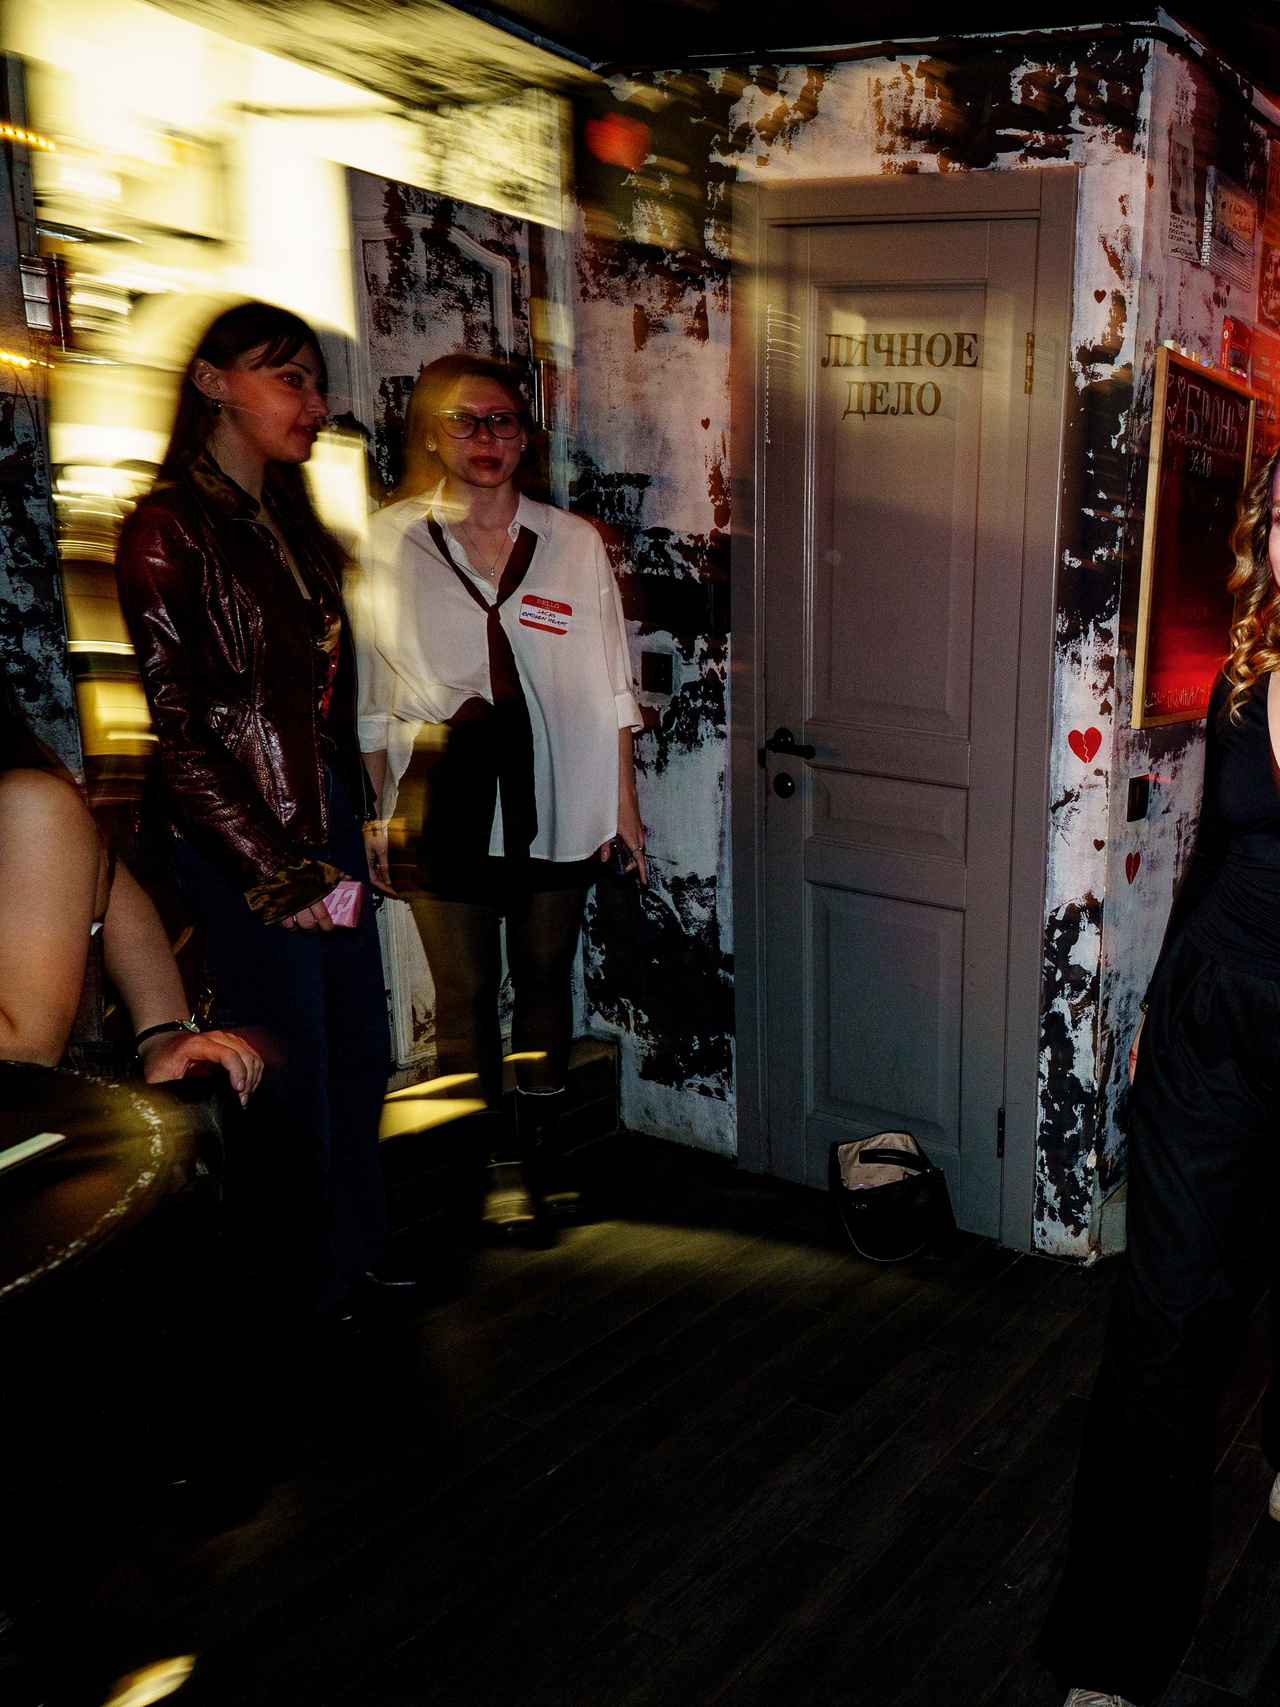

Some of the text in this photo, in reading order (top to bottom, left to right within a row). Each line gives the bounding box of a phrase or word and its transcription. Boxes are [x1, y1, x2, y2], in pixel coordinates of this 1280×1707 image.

[820, 332, 979, 368] ЛИЧНОЕ
[842, 380, 942, 421] ДЕЛО
[1184, 383, 1238, 452] БРОНЬ
[535, 609, 557, 618] JACKS
[536, 598, 560, 609] HELLO
[521, 611, 570, 627] BROKEN HEART
